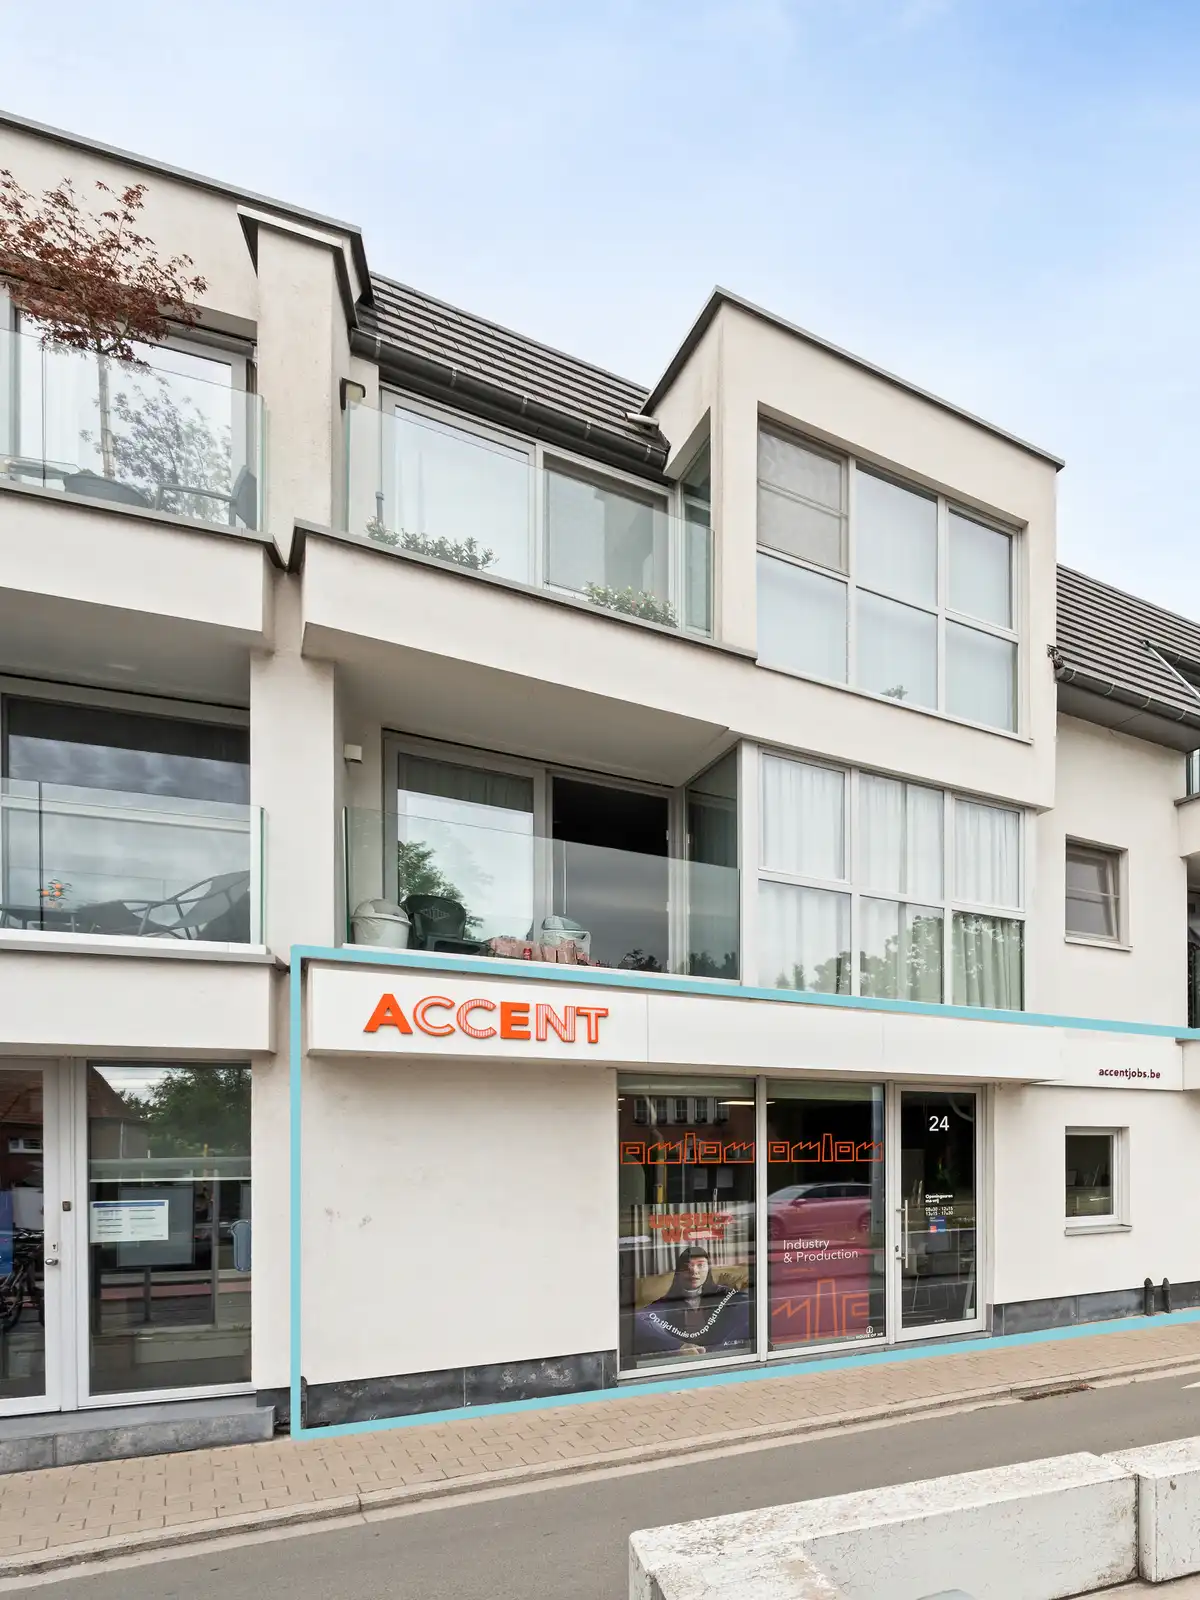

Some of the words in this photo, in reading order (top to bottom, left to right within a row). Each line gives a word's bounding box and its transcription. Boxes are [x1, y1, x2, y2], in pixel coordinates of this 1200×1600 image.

[363, 993, 609, 1043] ACCENT
[1098, 1068, 1161, 1080] accentjobs.be
[929, 1115, 950, 1131] 24
[783, 1238, 830, 1251] Industry
[783, 1252, 792, 1264] &
[796, 1249, 858, 1263] Production
[649, 1312, 661, 1323] Op
[671, 1327, 690, 1338] thuis
[699, 1324, 710, 1334] op
